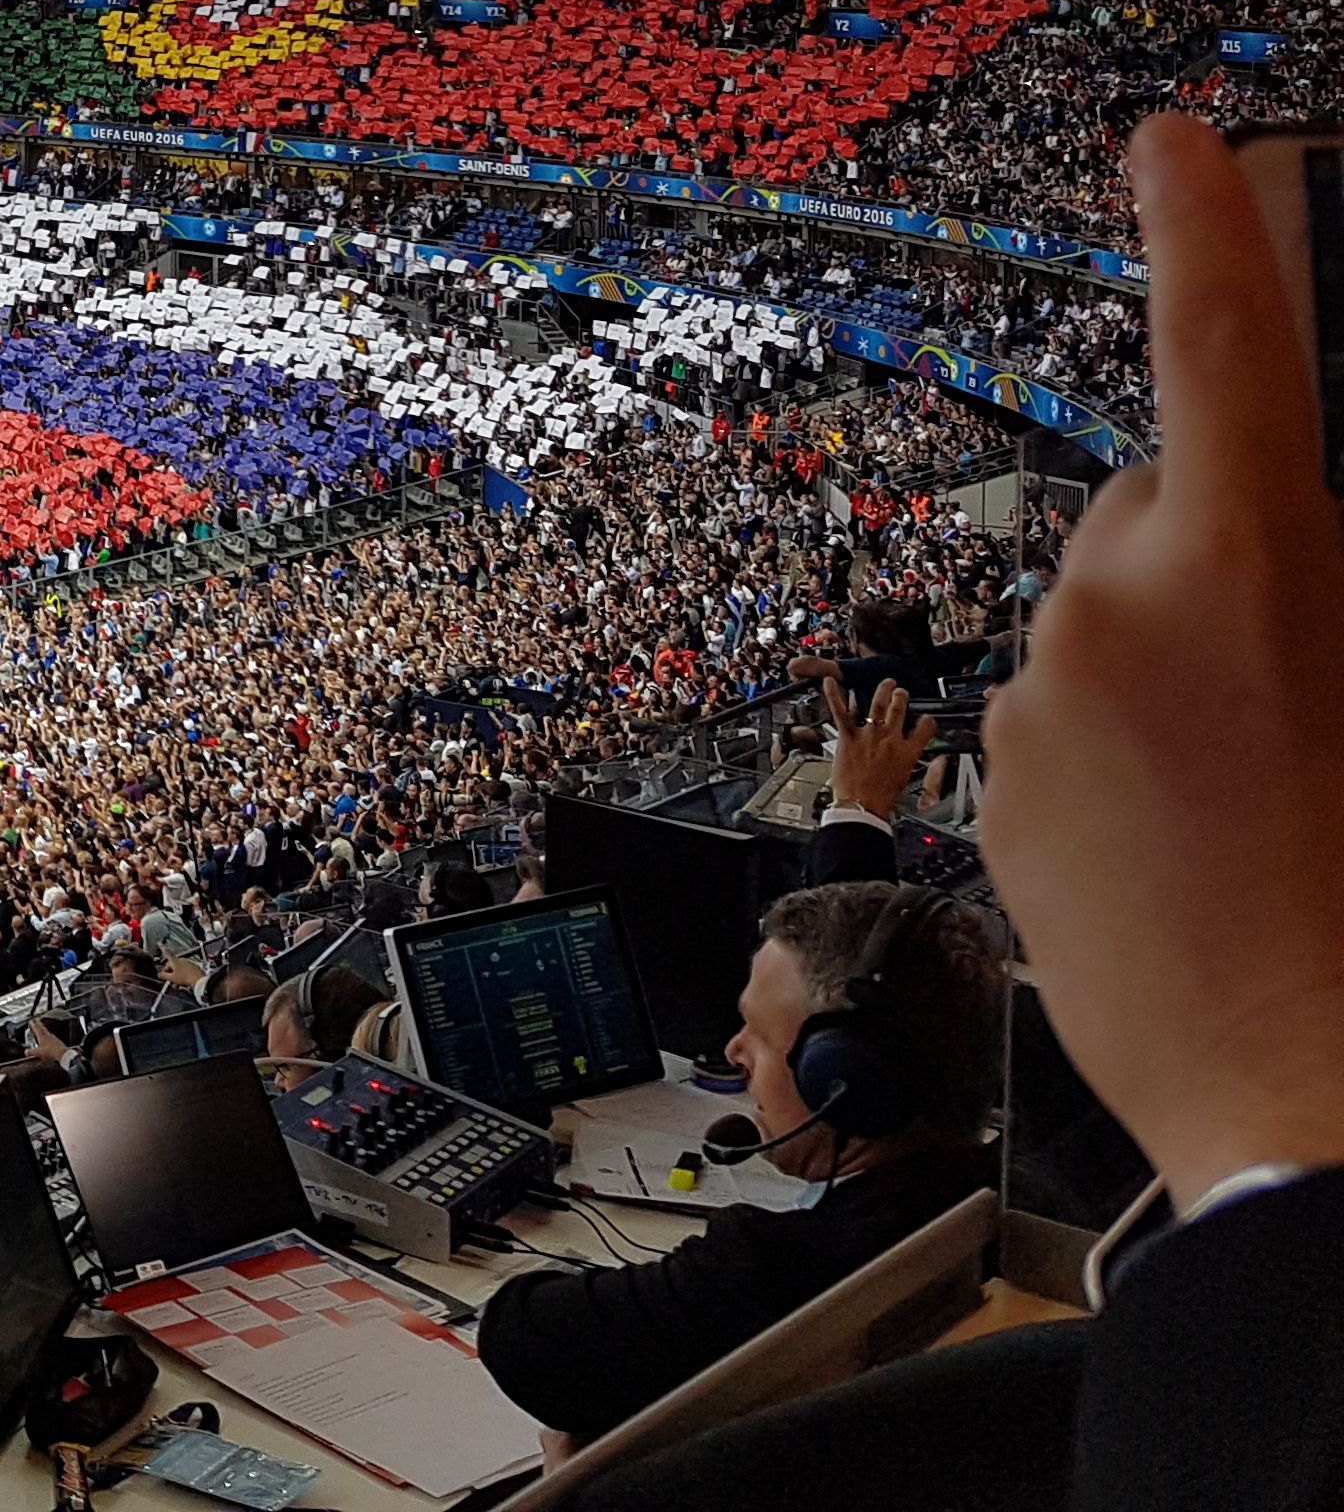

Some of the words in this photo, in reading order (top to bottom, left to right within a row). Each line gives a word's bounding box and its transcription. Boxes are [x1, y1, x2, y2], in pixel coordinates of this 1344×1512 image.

[440, 3, 462, 16] Y14
[835, 19, 850, 32] Y2
[1221, 40, 1241, 56] X15
[90, 126, 122, 140] UEFA
[123, 129, 154, 142] EURO
[155, 131, 185, 145] 2016
[458, 158, 530, 179] SAINT-DENIS
[799, 198, 829, 217] UEFA
[829, 202, 861, 221] EURO
[863, 209, 894, 226] 2016
